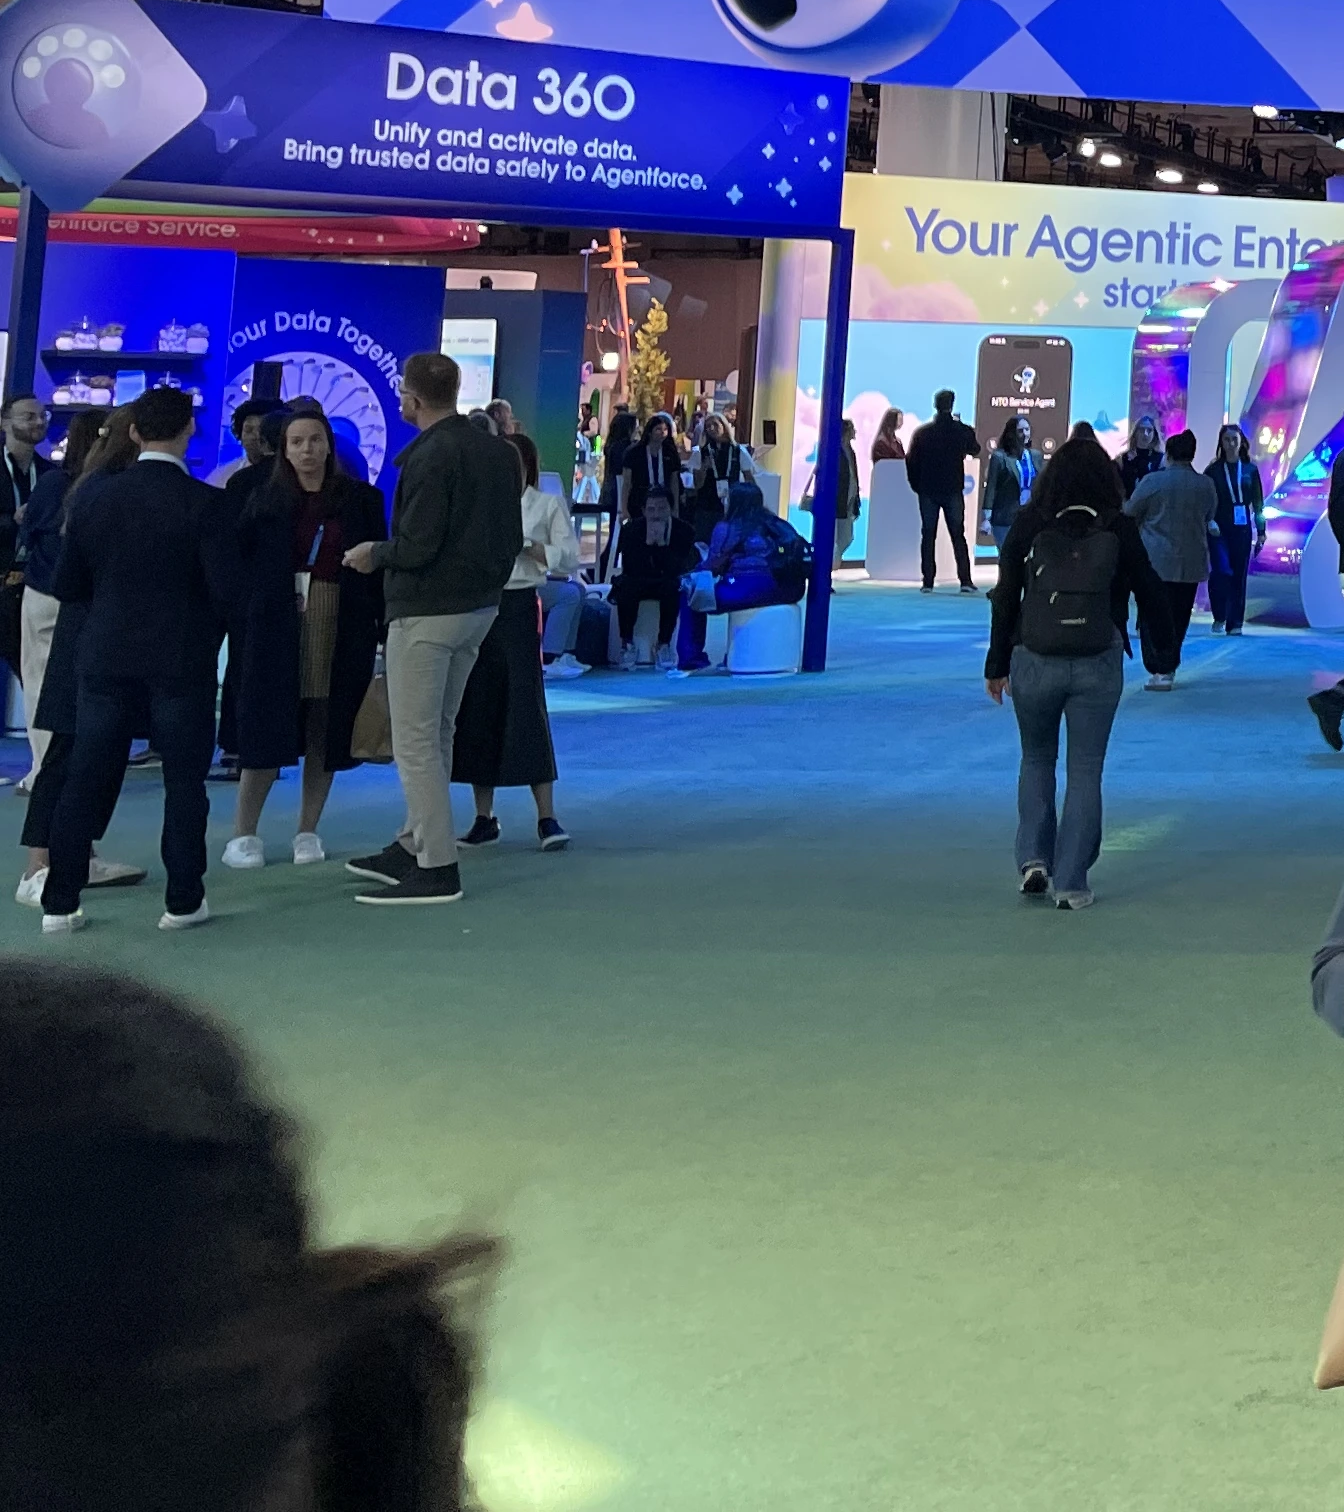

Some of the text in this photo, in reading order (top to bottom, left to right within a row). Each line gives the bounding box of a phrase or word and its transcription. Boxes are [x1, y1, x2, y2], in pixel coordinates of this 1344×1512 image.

[386, 52, 636, 121] Data 360
[283, 138, 708, 191] Bring trusted data safely to Agentforce.
[373, 119, 637, 162] Unify and activate data.
[147, 221, 240, 237] Service.
[905, 207, 1018, 257] Your
[1026, 215, 1224, 272] Agentic
[1103, 277, 1177, 308] star
[275, 309, 331, 333] Data
[337, 317, 403, 398] Togethe
